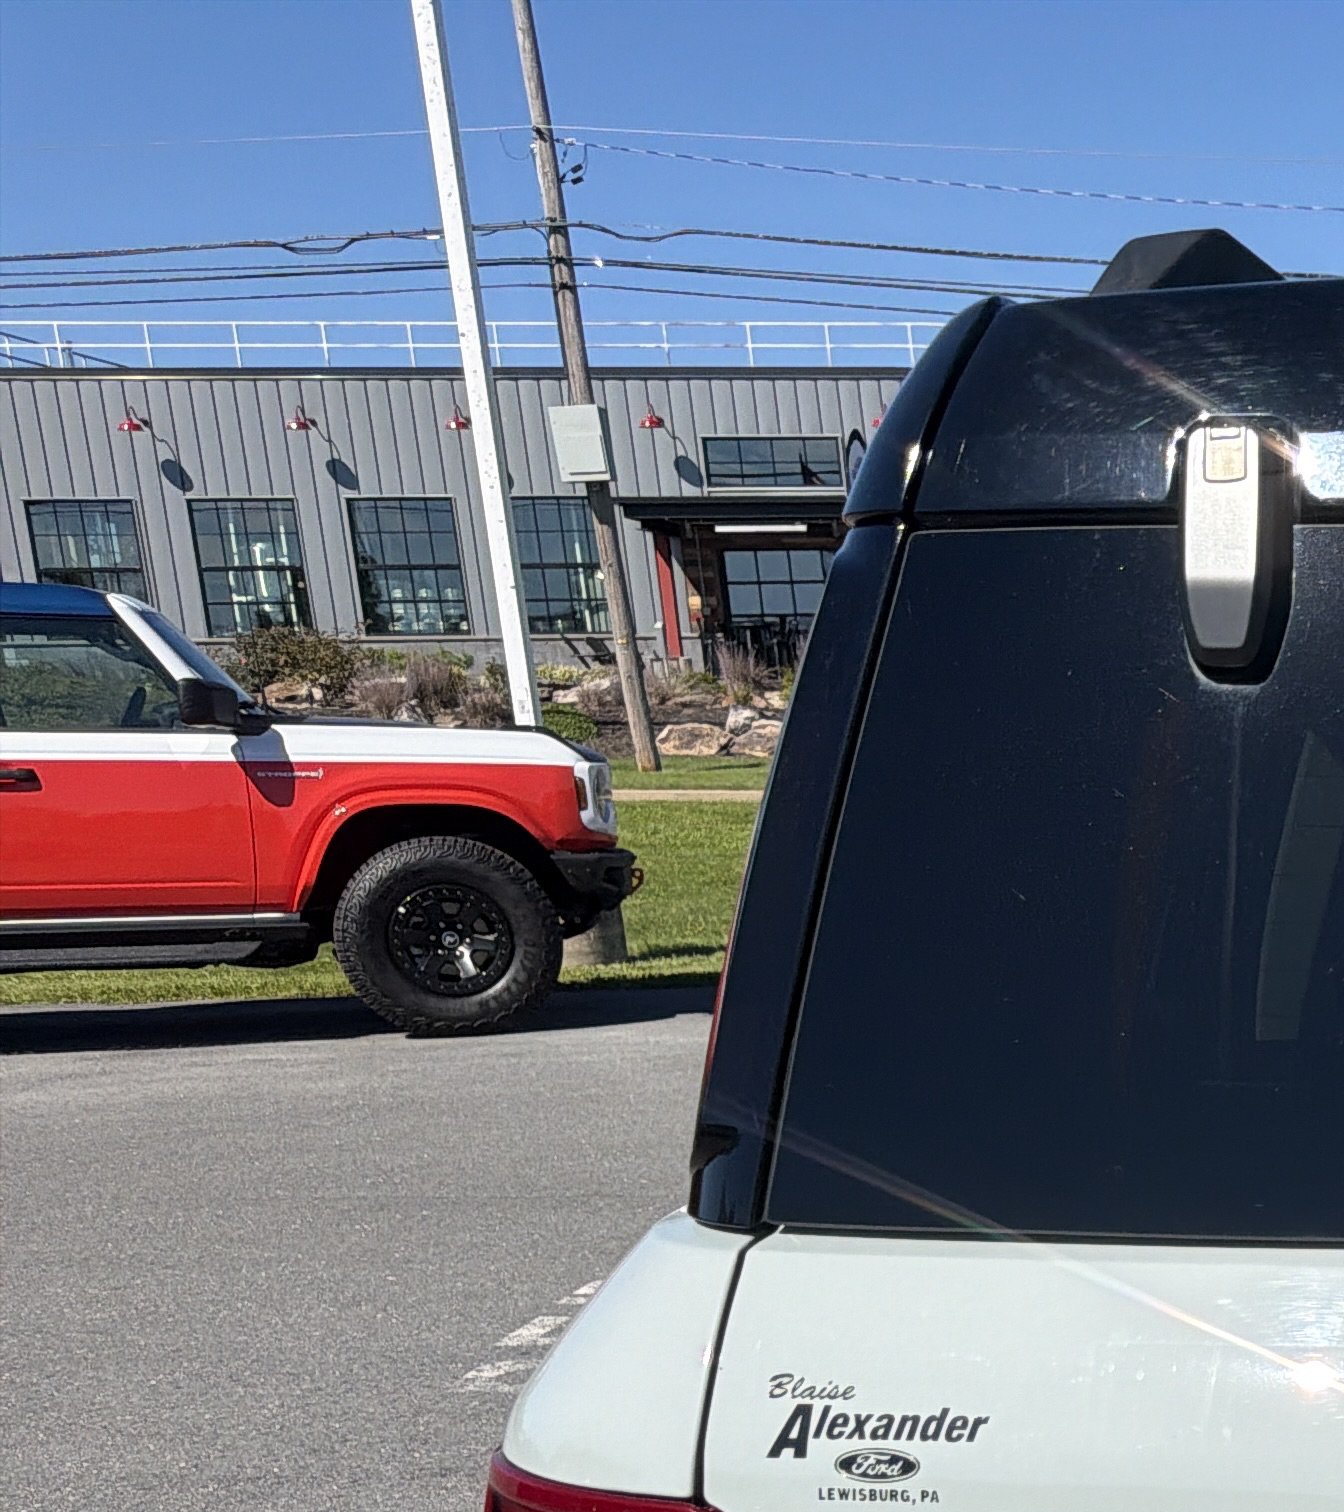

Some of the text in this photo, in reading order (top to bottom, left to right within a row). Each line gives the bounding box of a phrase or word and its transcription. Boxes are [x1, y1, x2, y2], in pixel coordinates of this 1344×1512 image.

[767, 1372, 856, 1400] Blaise
[765, 1403, 991, 1459] Alexander
[850, 1453, 903, 1477] Ford
[818, 1487, 940, 1506] LEWISBURG, PA
